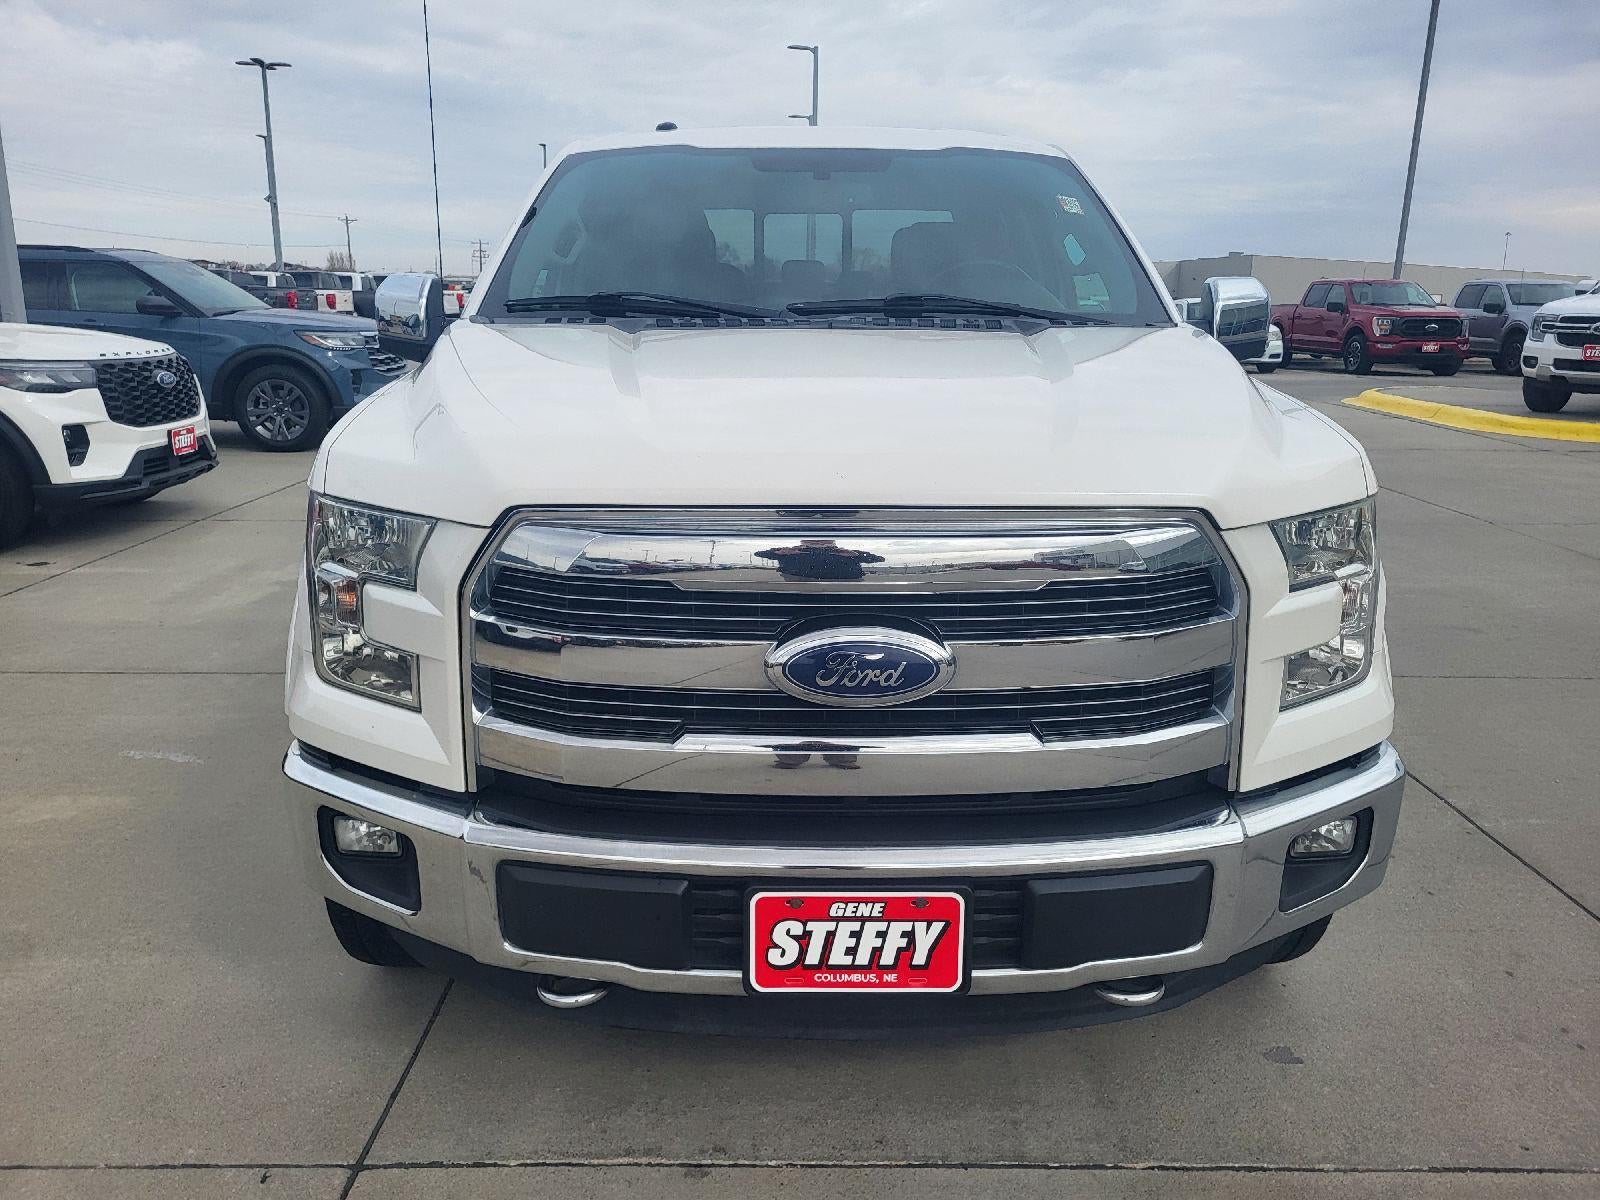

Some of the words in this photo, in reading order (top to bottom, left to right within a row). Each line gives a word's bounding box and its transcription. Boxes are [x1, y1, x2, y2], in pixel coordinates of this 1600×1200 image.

[1585, 349, 1600, 357] STE
[175, 433, 194, 449] STEFFY
[815, 651, 907, 687] Ford
[828, 902, 886, 918] GENE
[767, 919, 949, 970] STEFFY
[814, 973, 880, 983] COLUMBUS,
[883, 973, 898, 983] NE
